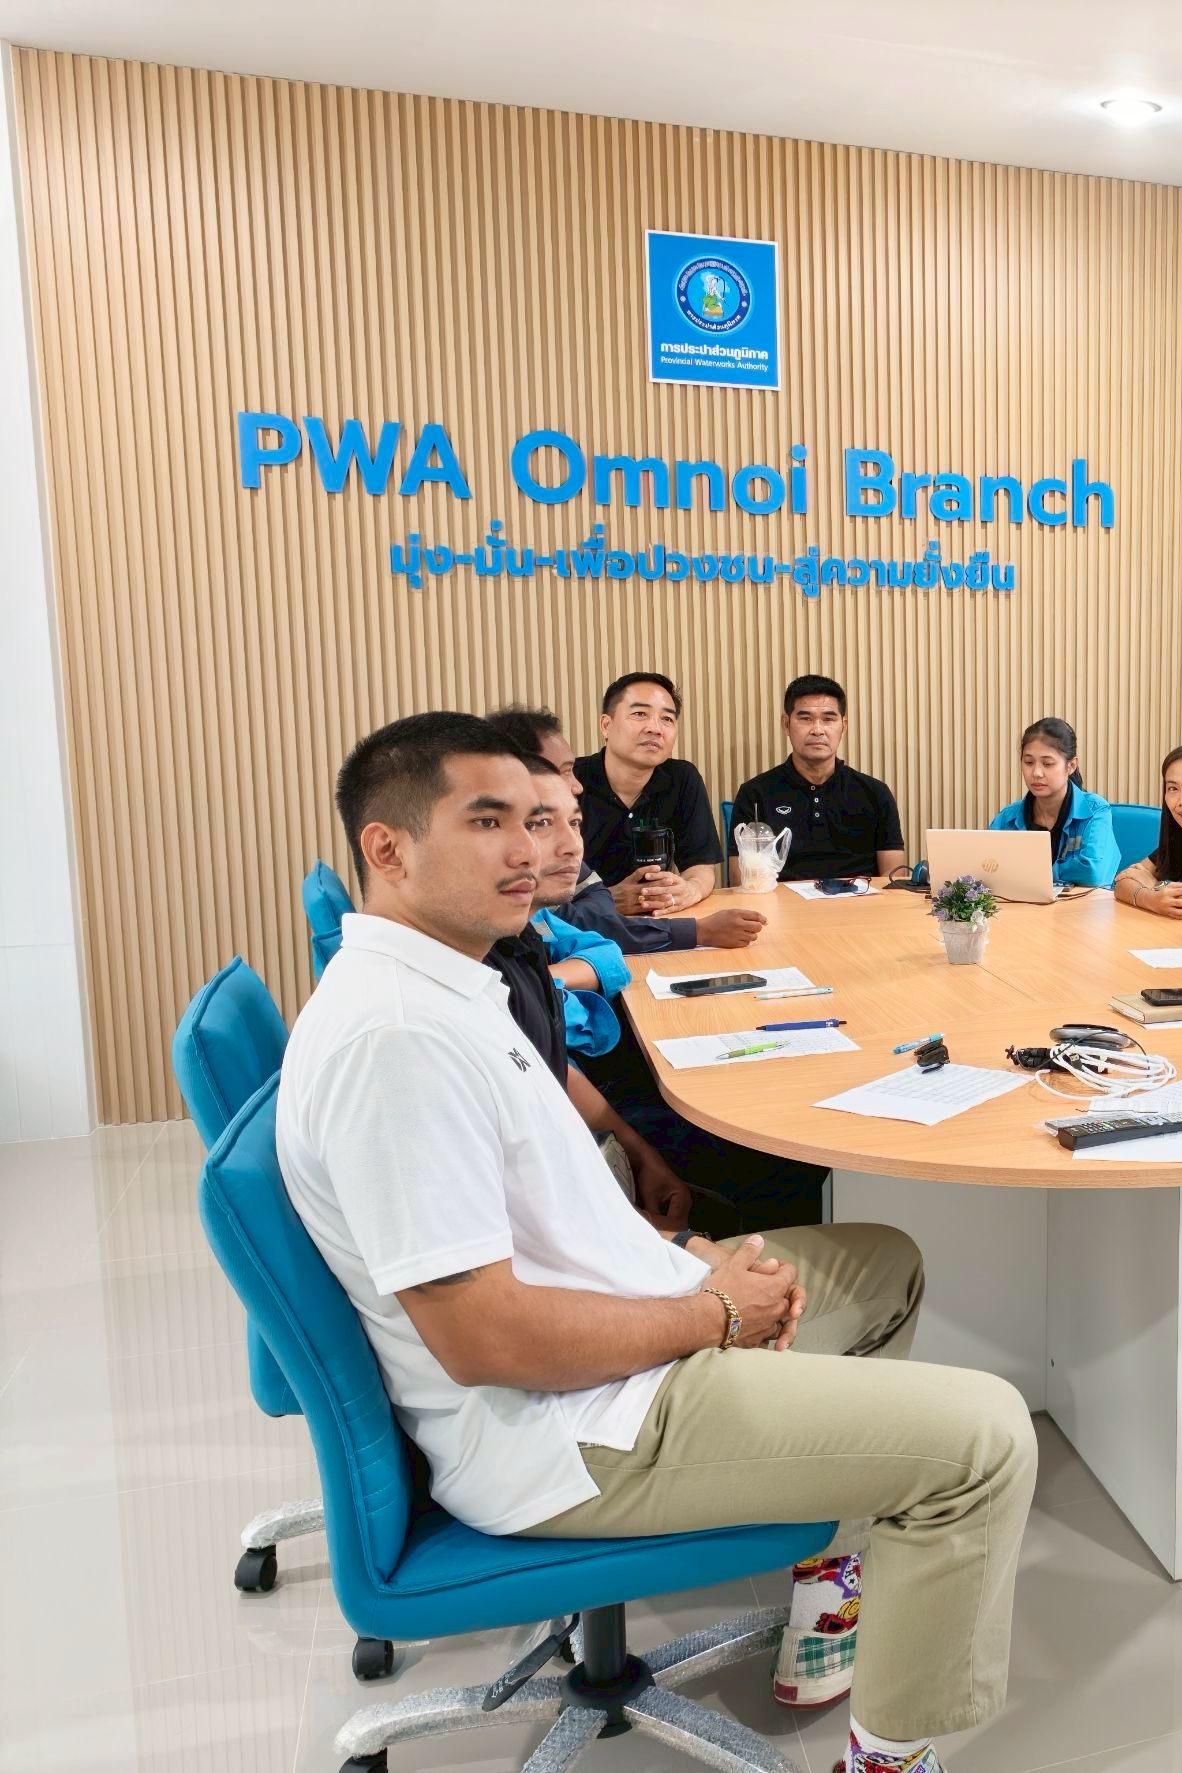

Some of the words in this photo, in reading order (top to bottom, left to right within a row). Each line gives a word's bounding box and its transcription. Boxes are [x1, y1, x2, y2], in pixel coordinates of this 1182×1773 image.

[660, 343, 769, 361] การประปาส่วนภูมิภาค
[660, 356, 693, 366] Provincial
[695, 358, 735, 369] Waterworks
[737, 362, 768, 372] Authority
[237, 411, 472, 499] PWA
[511, 429, 808, 515] Omnoi
[844, 448, 1115, 529] Branch
